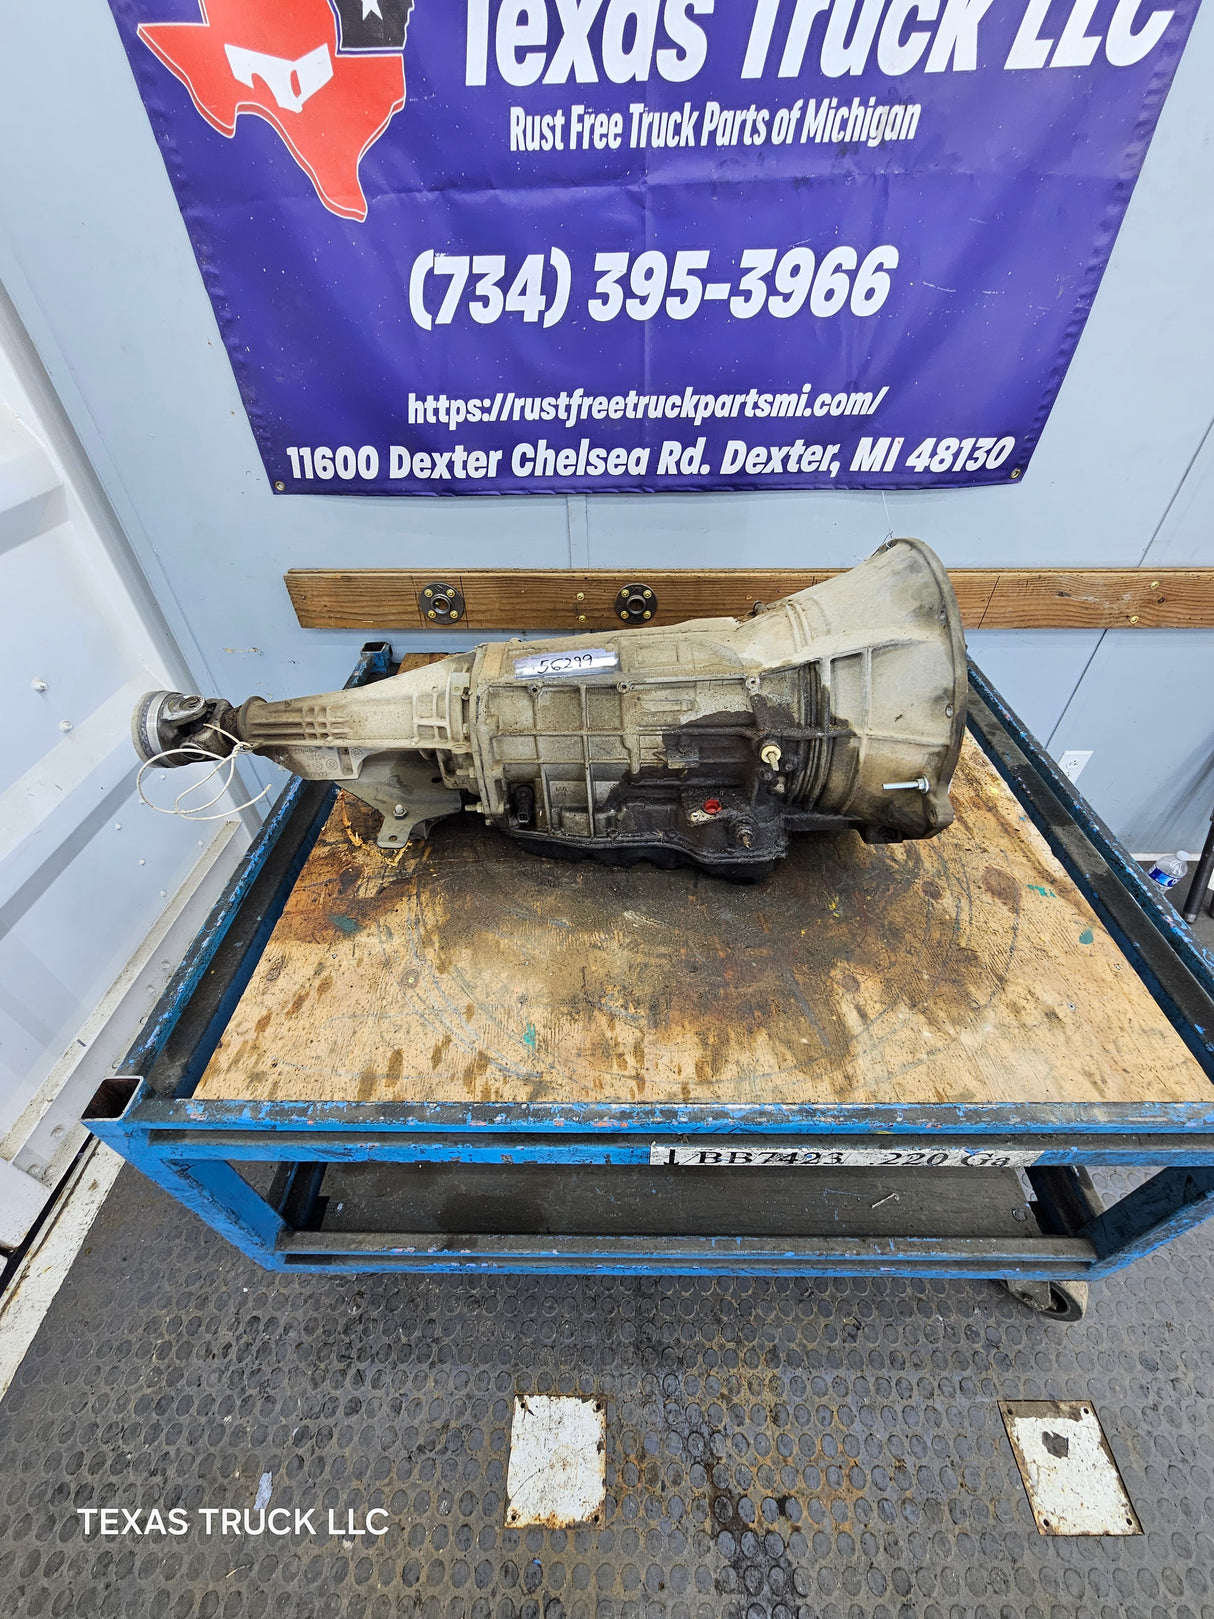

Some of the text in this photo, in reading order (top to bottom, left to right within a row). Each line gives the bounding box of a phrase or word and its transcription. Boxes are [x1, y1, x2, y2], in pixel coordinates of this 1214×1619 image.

[740, 0, 994, 79] Truck
[1002, 0, 1177, 70] LLC
[510, 96, 922, 152] Rust Free Truck Parts of Michigan
[409, 244, 900, 331] (734) 395-3966
[408, 384, 890, 431] https://rustfreetruckpartsmi.com/
[286, 436, 1016, 481] 11600 Dexter Chelsea Rd. Dexter, MI 48130
[537, 653, 593, 674] 56299
